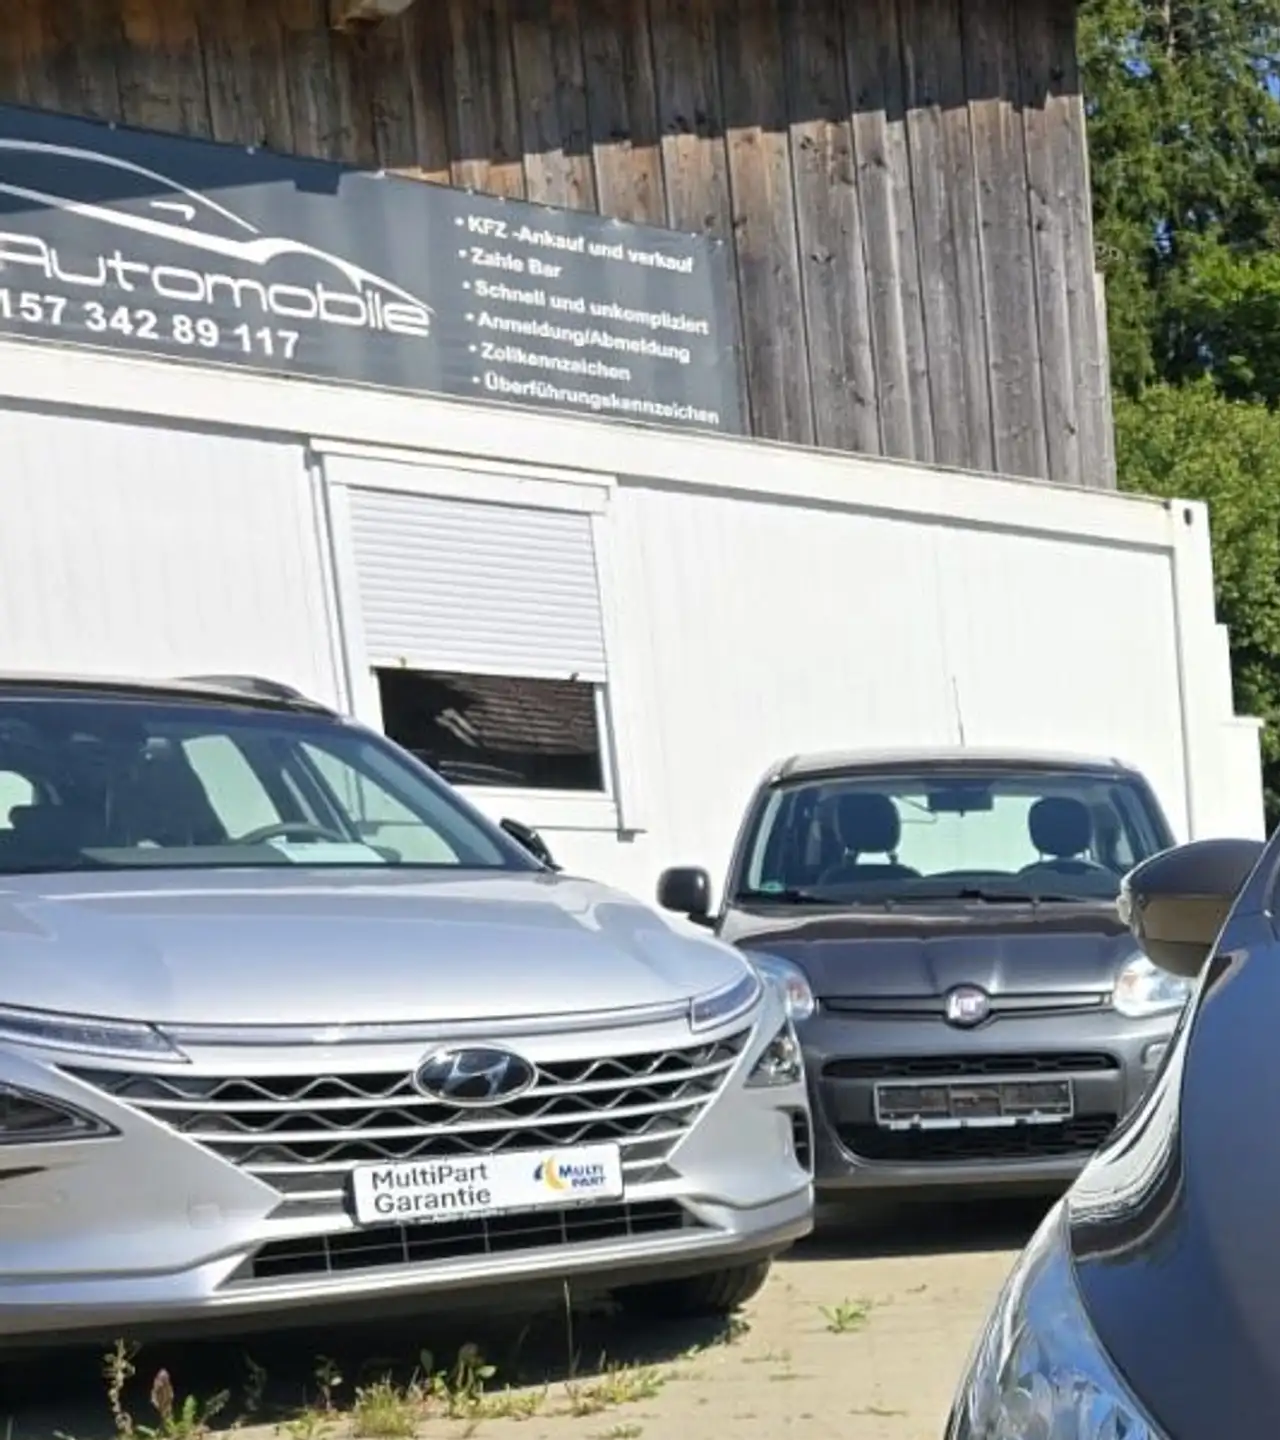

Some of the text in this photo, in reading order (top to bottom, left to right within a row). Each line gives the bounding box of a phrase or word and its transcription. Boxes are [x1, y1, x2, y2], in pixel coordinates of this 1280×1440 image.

[467, 215, 508, 240] KFZ
[588, 242, 623, 261] und
[628, 248, 694, 274] verkauf
[470, 246, 563, 278] Zahle Bar
[0, 231, 430, 338] Automobile
[474, 280, 709, 335] Schnell und unkompliziert
[0, 287, 299, 359] 157 342 89 117
[477, 311, 691, 364] Anmeldung/Abmeldung
[481, 342, 631, 381] Zollkennzeichen
[484, 370, 720, 425] Überführungskennzeichen
[371, 1161, 489, 1192] MultiPart
[374, 1186, 492, 1214] Garantie
